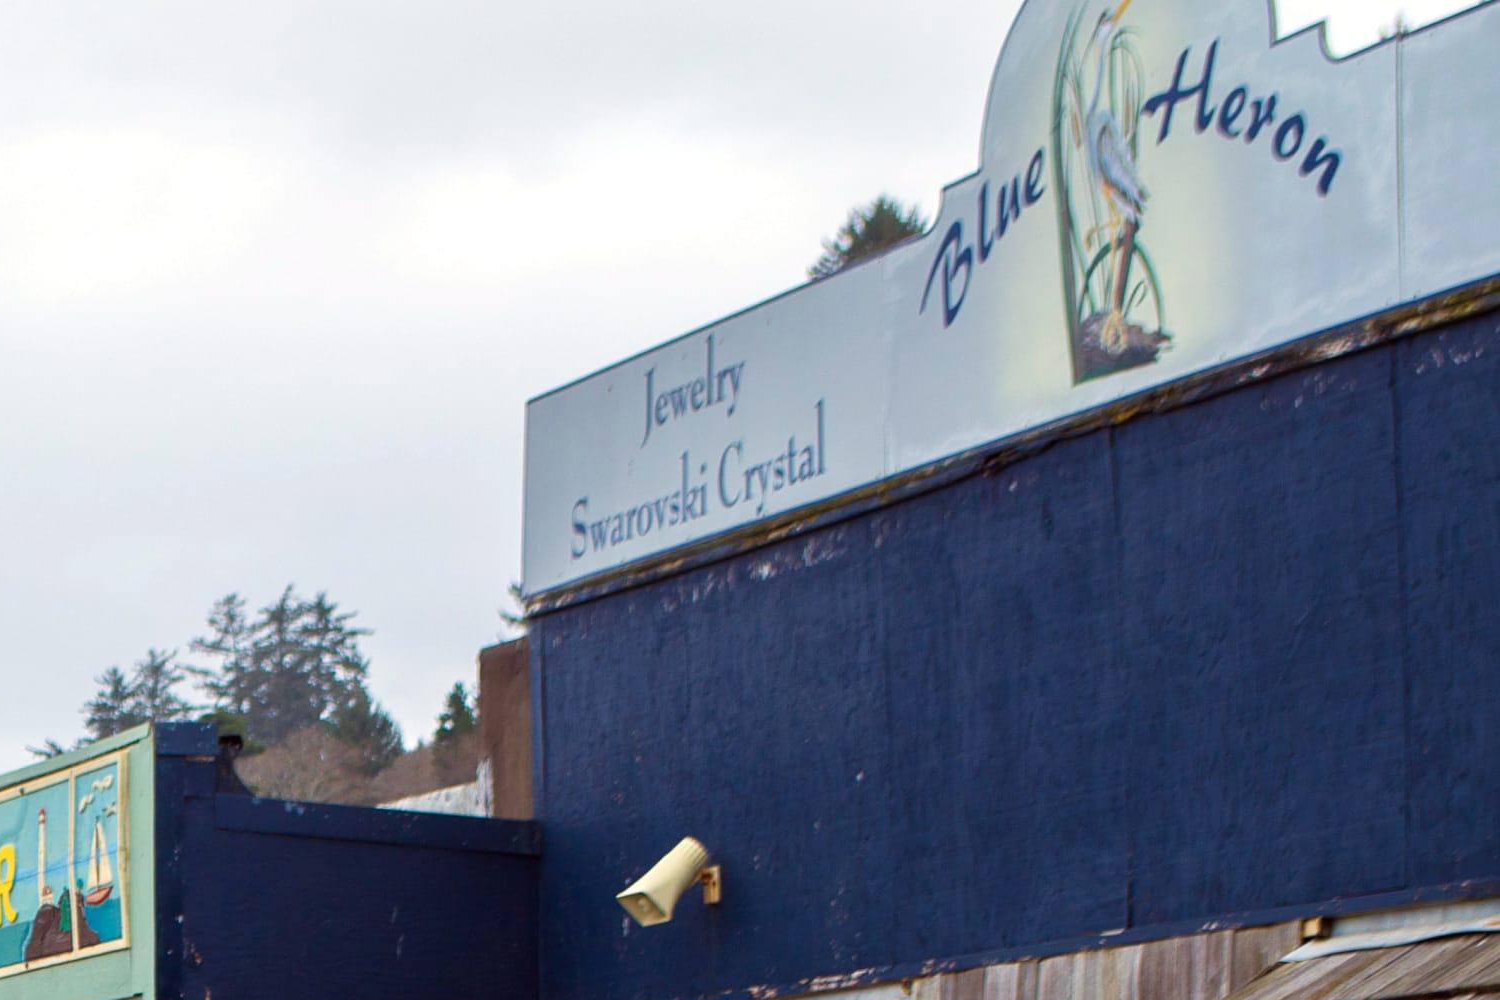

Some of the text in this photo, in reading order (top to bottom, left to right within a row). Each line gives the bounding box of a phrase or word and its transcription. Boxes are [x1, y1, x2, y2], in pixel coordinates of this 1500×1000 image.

[919, 36, 1345, 329] Blue Heron
[640, 333, 745, 449] Jewelry
[571, 397, 826, 561] Swarovski Crystal
